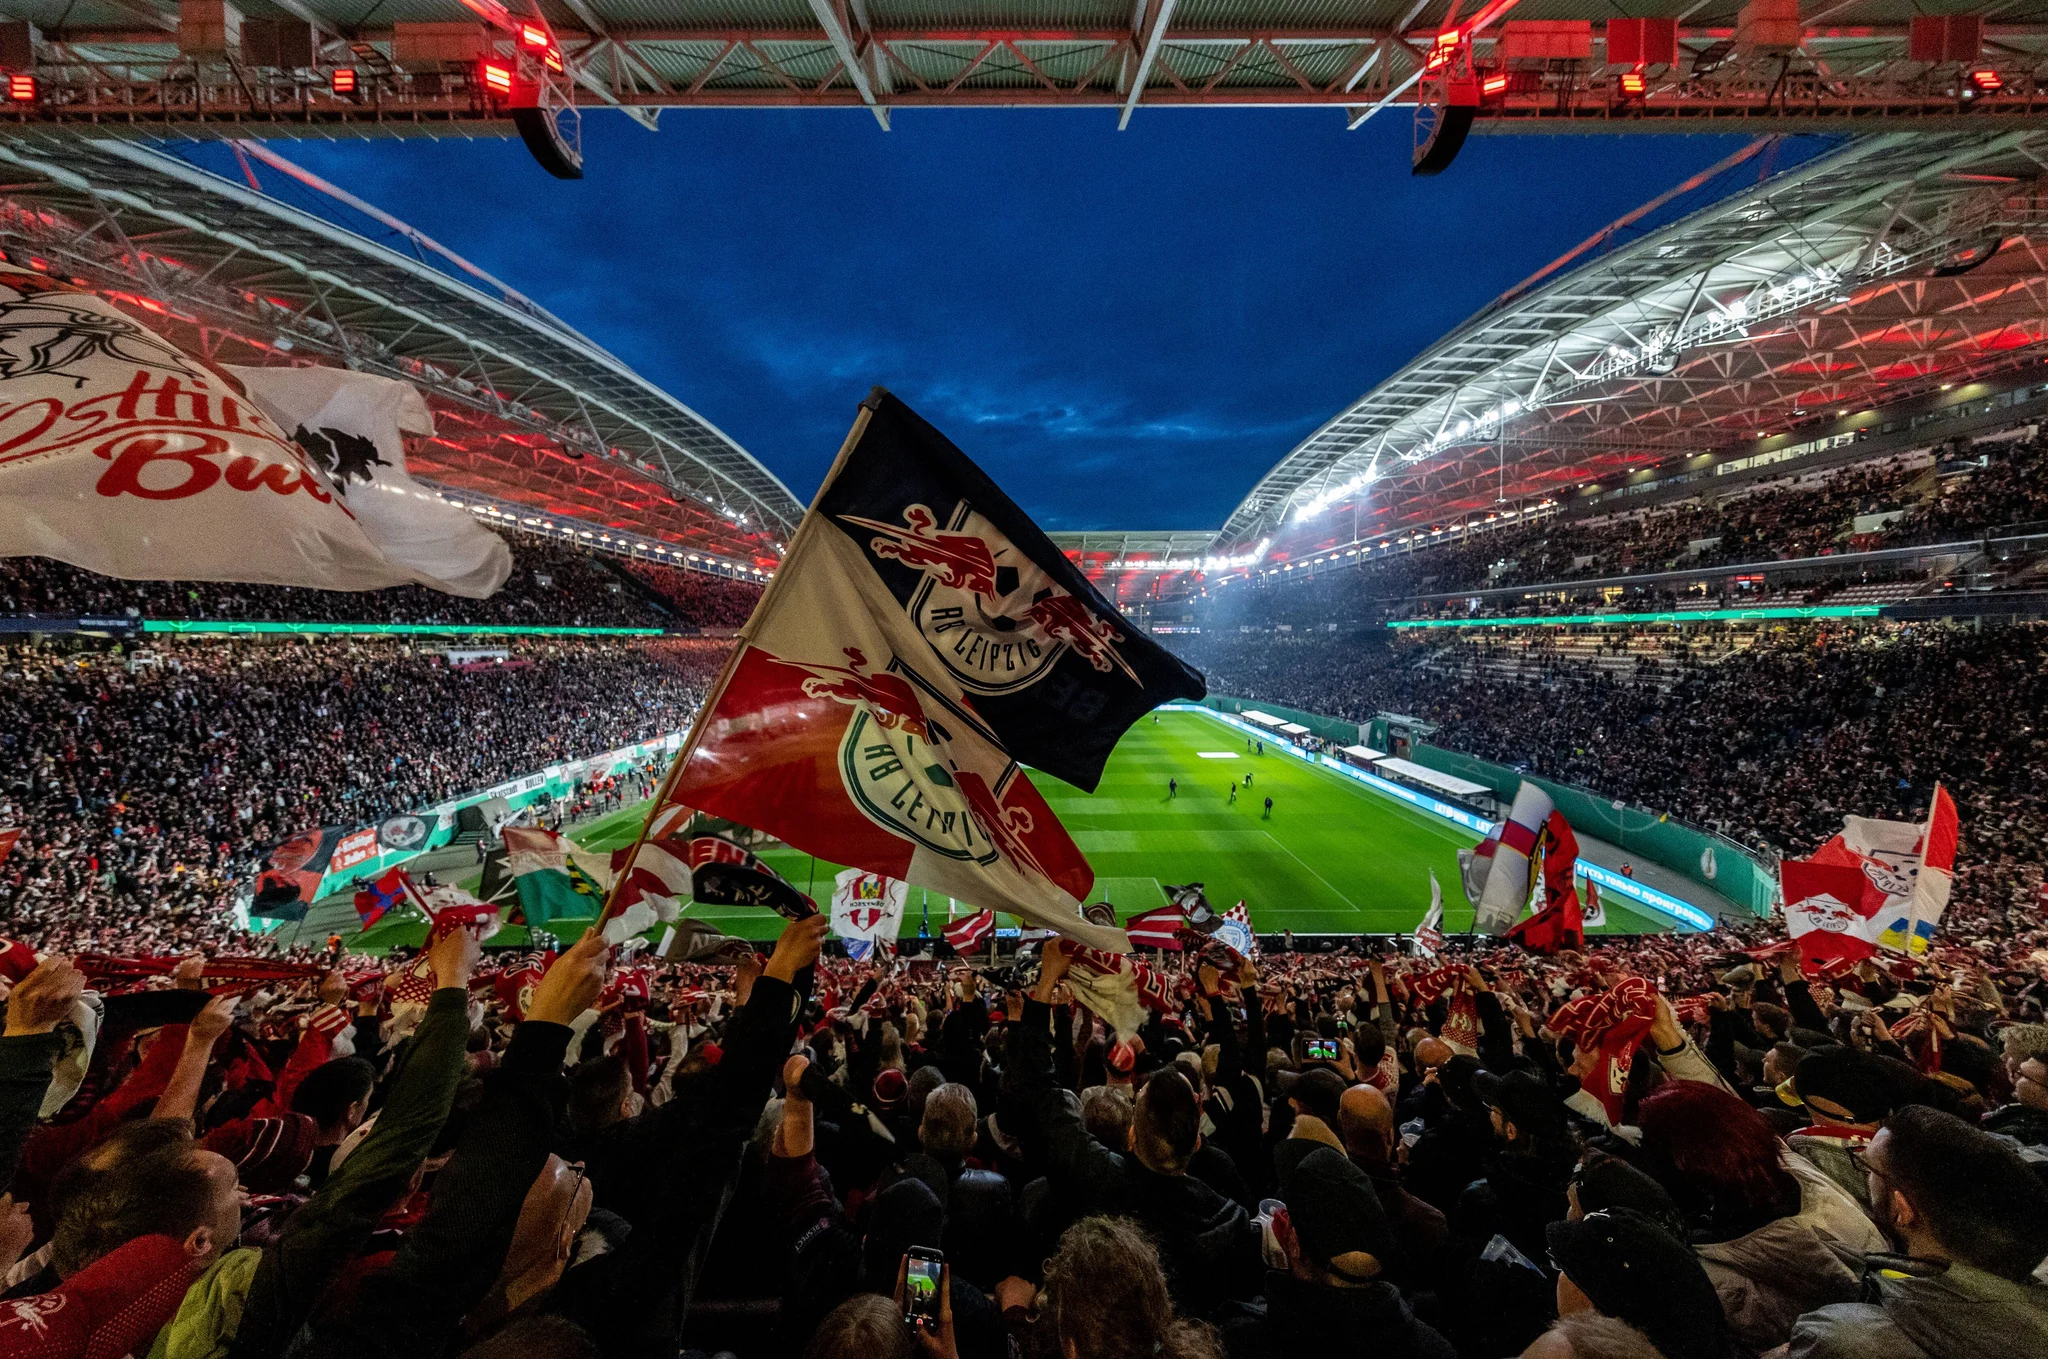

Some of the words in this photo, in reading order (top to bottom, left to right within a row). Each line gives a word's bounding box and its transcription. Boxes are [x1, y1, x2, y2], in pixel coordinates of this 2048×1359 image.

[931, 607, 965, 633] RB
[954, 628, 1041, 671] LEIPZIG
[794, 1223, 820, 1251] RESPECT
